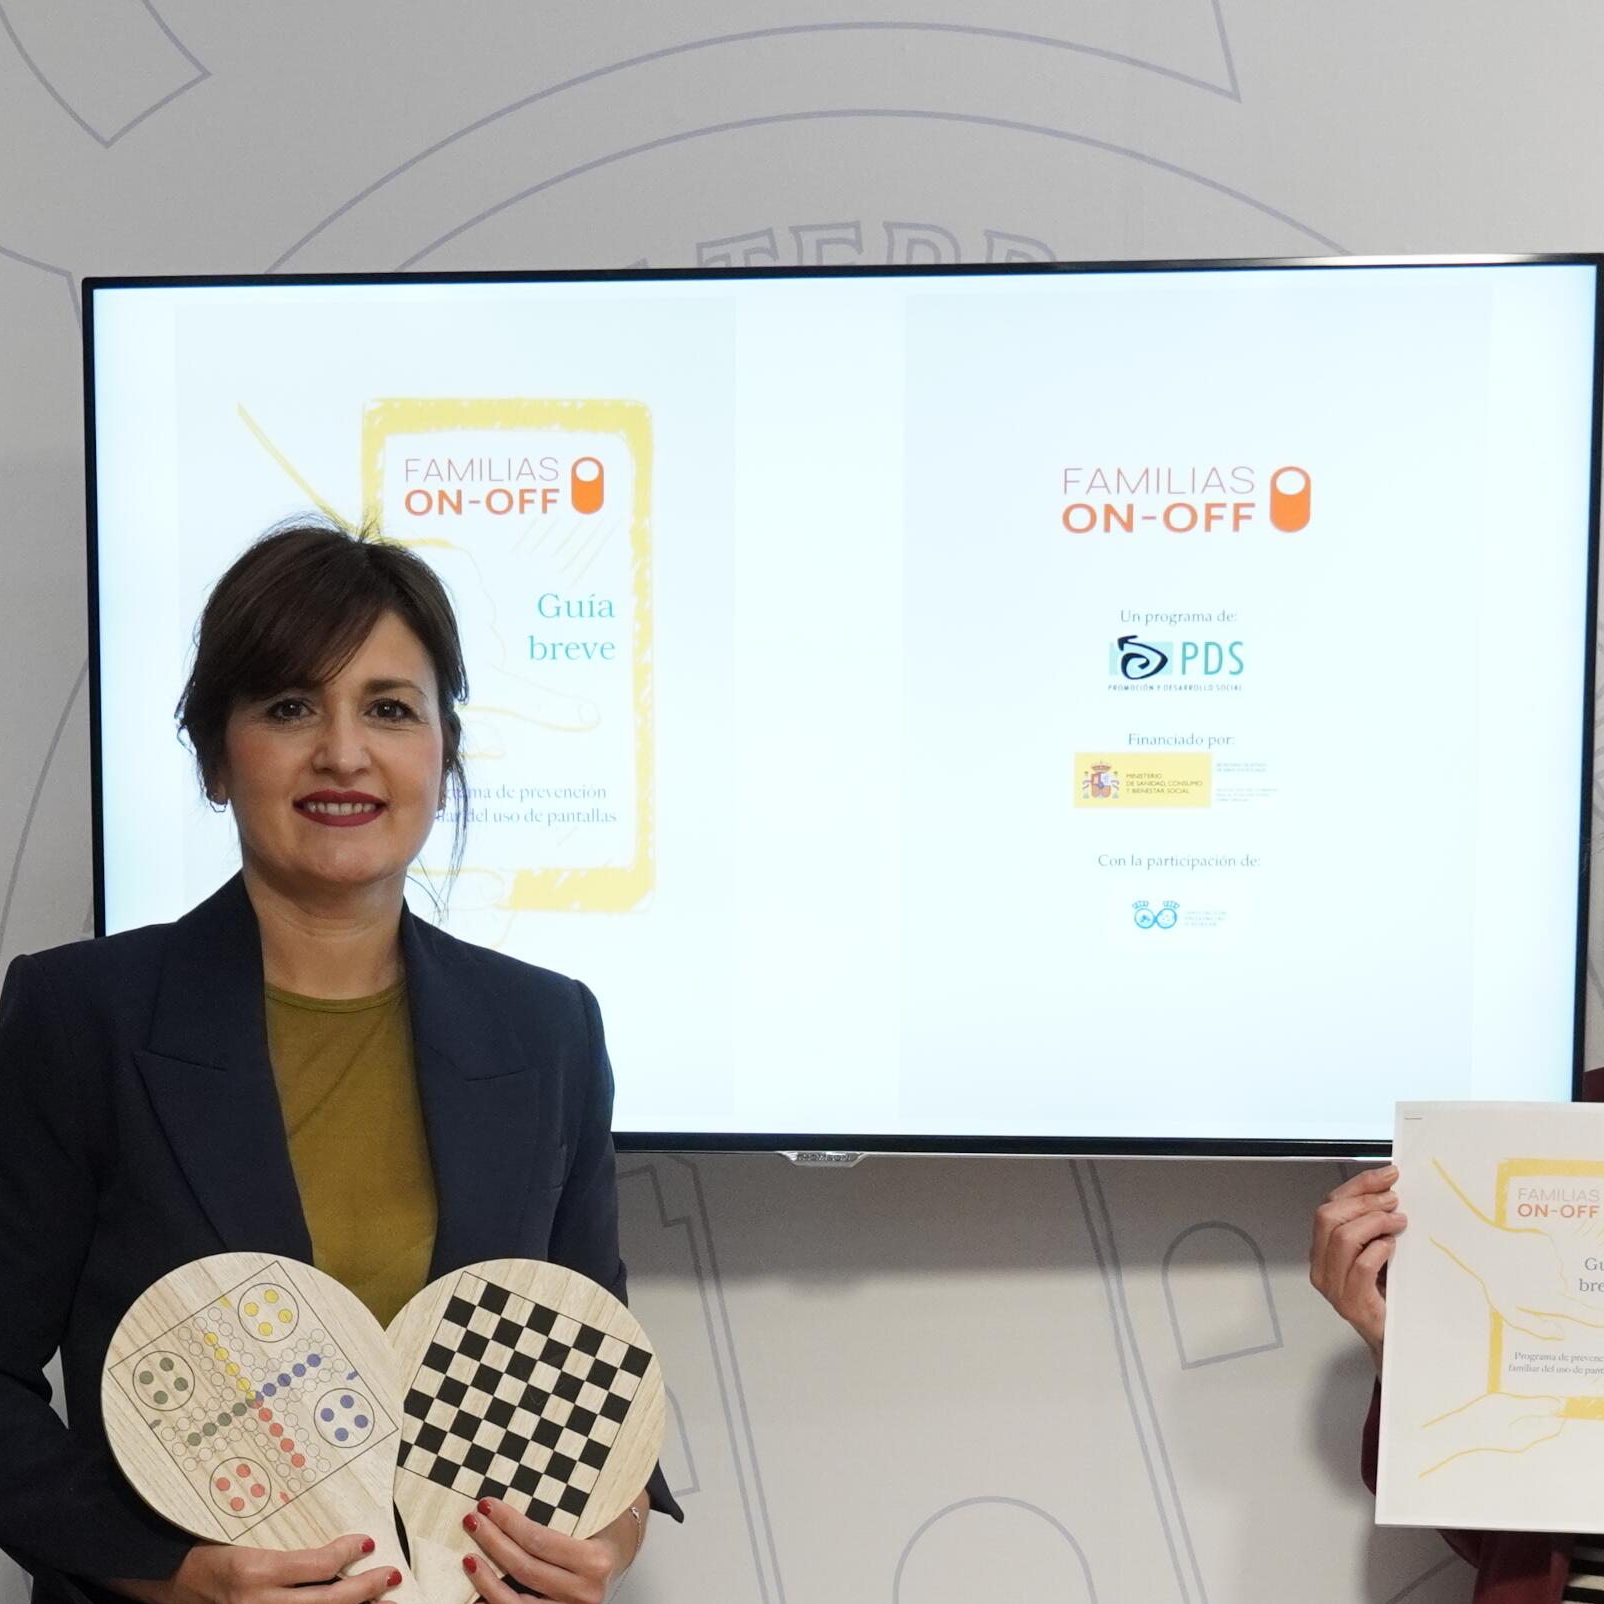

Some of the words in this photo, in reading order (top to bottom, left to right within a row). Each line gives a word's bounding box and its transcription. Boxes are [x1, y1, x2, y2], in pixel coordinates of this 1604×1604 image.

[404, 457, 559, 483] FAMILIAS
[1063, 466, 1255, 495] FAMILIAS
[404, 488, 560, 516] ON-OFF
[1062, 502, 1256, 534] ON-OFF
[536, 592, 615, 619] Guía
[1120, 609, 1141, 623] Un
[1144, 611, 1212, 627] programa
[528, 634, 616, 661] breve
[1181, 640, 1245, 676] PDS
[1128, 732, 1204, 746] Financiado
[495, 784, 516, 799] de
[519, 785, 607, 804] prevención
[493, 812, 521, 823] uso
[523, 807, 544, 823] de
[547, 807, 617, 827] pantallas
[1097, 854, 1127, 867] Con
[1130, 853, 1143, 867] la
[1147, 854, 1236, 871] participación
[1517, 1187, 1600, 1202] FAMILIAS
[1517, 1203, 1599, 1219] ON-OFF
